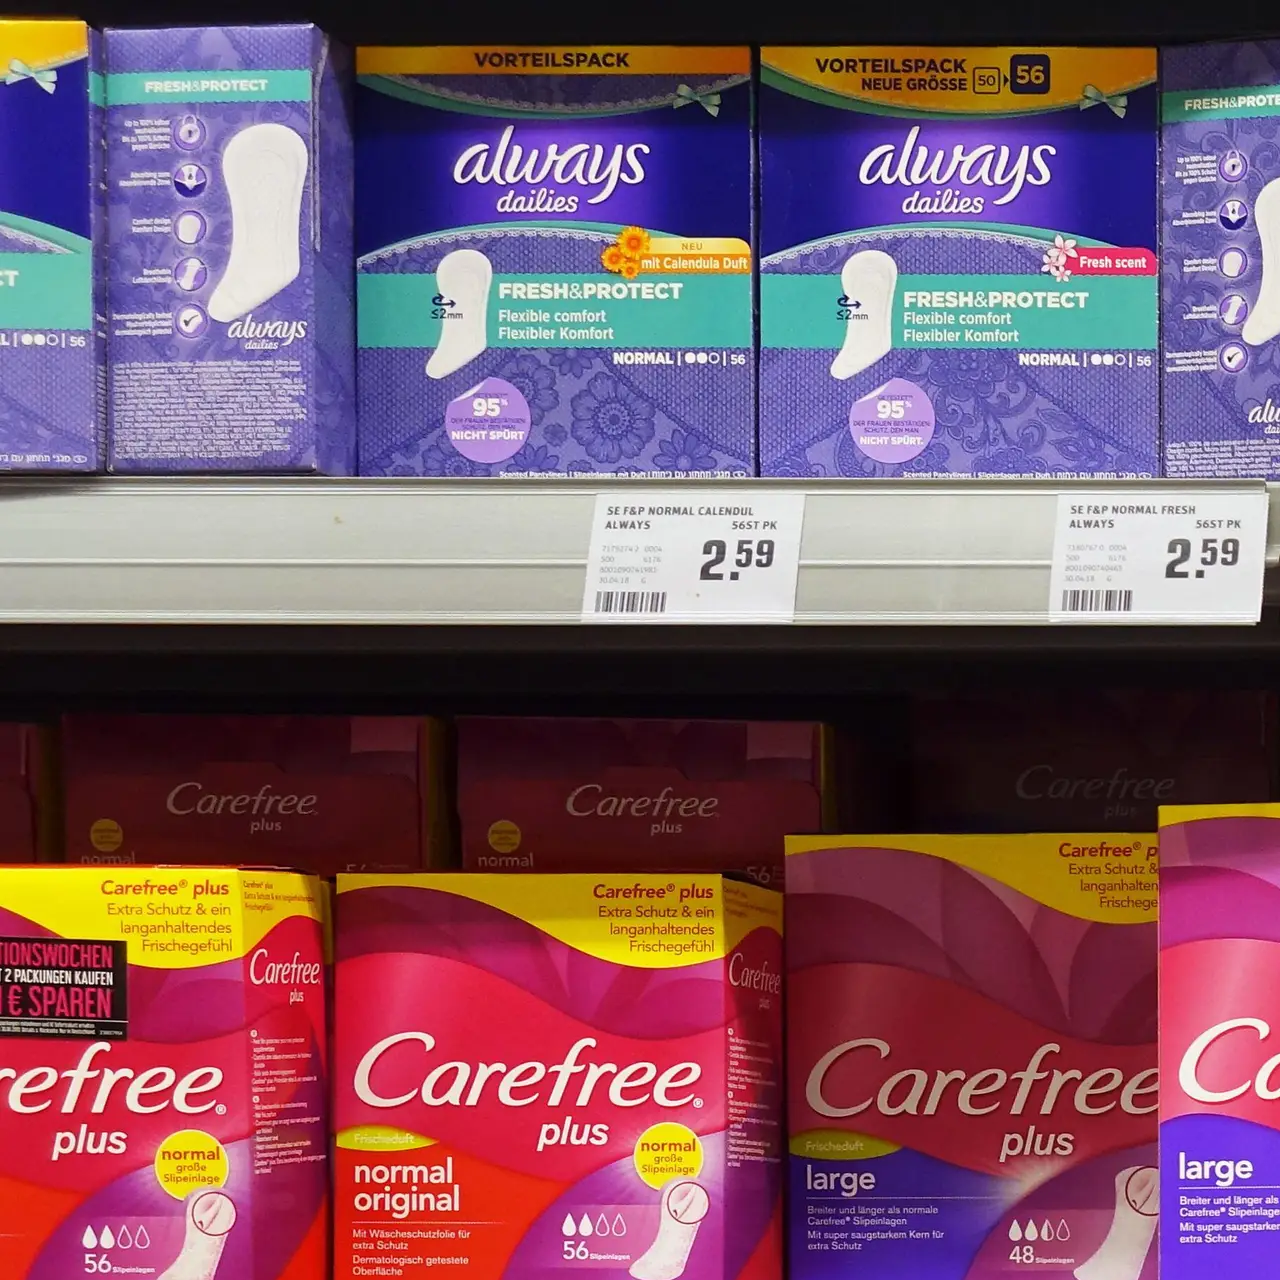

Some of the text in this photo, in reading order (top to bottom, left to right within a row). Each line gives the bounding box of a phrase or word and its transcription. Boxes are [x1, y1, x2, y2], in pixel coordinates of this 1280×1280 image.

[474, 52, 629, 68] VORTEILSPACK
[816, 58, 968, 74] VORTEILSPACK
[144, 78, 268, 94] FRESH&PROTECT
[861, 65, 1045, 91] NEUE GRÖSSE 50 56
[453, 126, 650, 205] always
[497, 191, 578, 214] dailies
[681, 242, 704, 251] NEU
[642, 255, 748, 271] mit Calendula Duft
[1079, 255, 1146, 269] Fresh scent
[499, 282, 683, 301] FRESH&PROTECT
[499, 309, 606, 324] Flexible comfort
[499, 326, 614, 341] Flexibler Komfort
[608, 507, 754, 516] SE F&P NORMAL CALENDUL
[605, 521, 778, 530] ALWAYS 56ST PK
[700, 540, 775, 581] 2.59
[353, 1032, 704, 1108] Carefree
[538, 1118, 609, 1151] plus
[354, 1157, 453, 1185] normal
[1179, 1152, 1254, 1182] large
[354, 1184, 460, 1218] original
